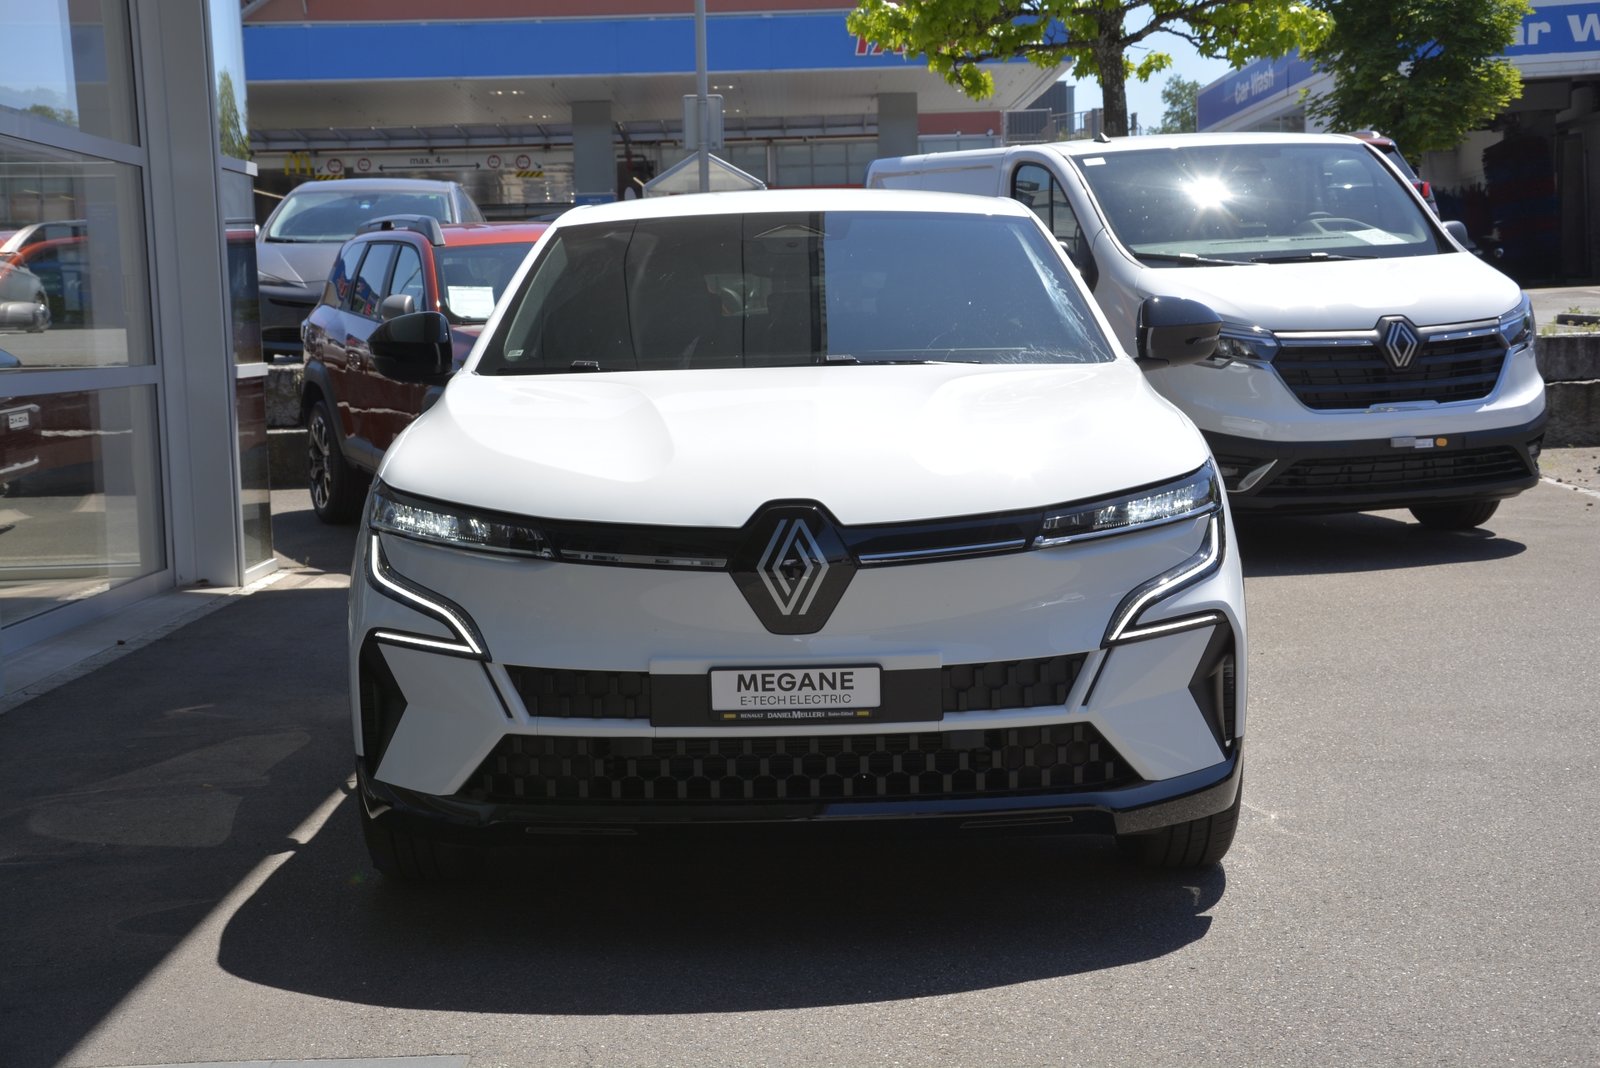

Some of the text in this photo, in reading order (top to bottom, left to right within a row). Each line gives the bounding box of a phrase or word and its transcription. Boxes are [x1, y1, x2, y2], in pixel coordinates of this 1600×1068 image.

[1505, 21, 1551, 46] ar
[1234, 64, 1274, 105] Car Wash
[737, 671, 854, 692] MEGANE
[740, 693, 852, 706] E-TECH ELECTRIC
